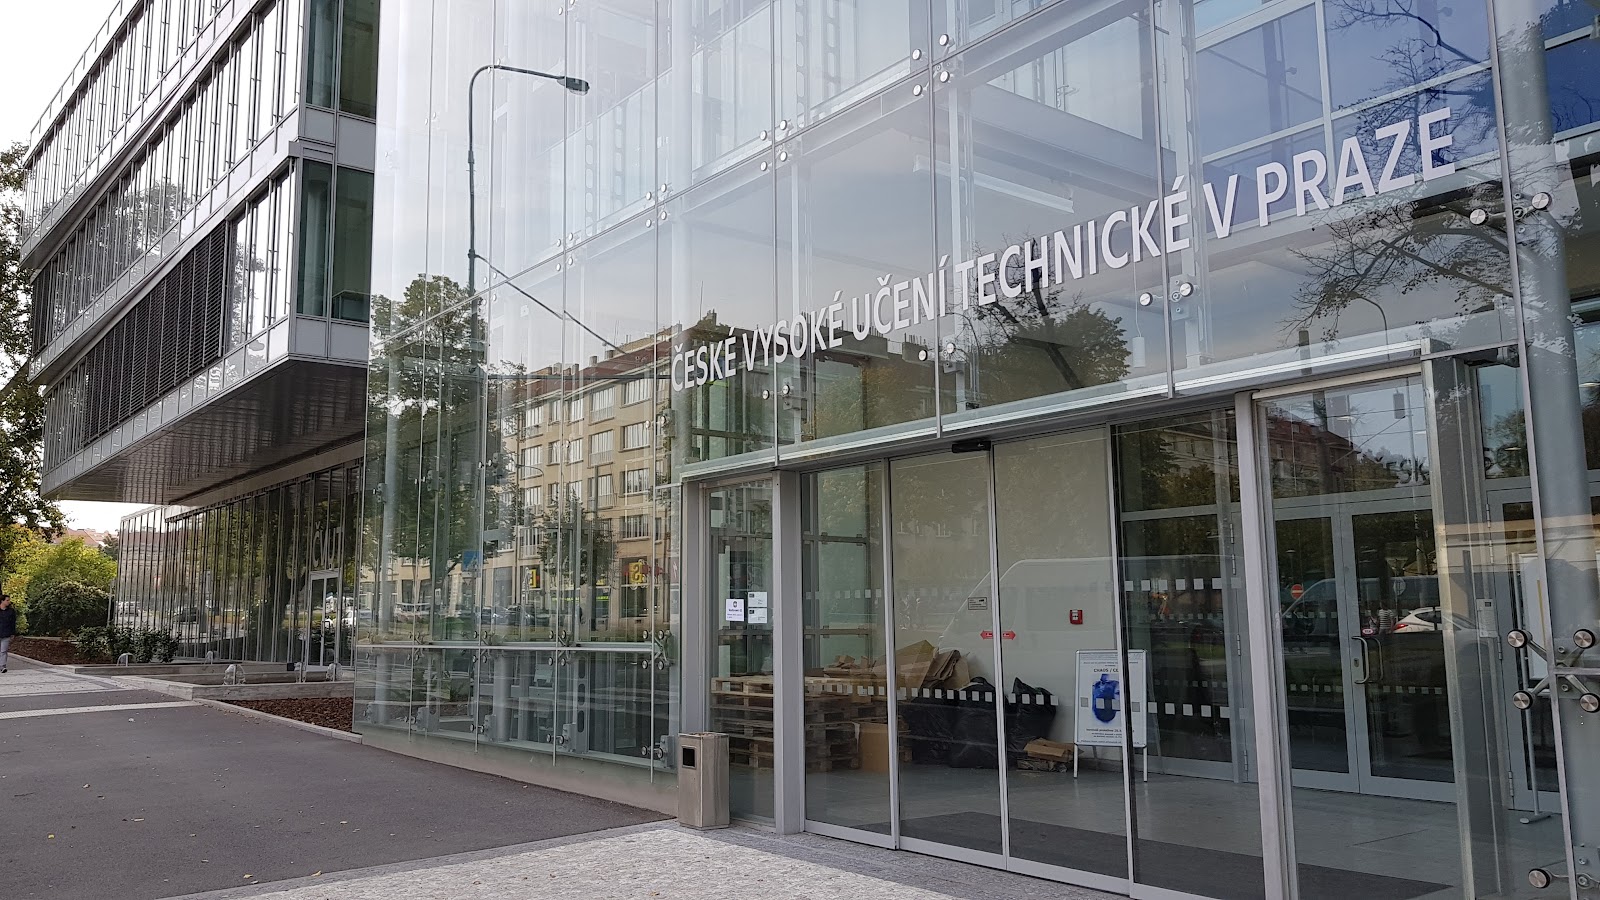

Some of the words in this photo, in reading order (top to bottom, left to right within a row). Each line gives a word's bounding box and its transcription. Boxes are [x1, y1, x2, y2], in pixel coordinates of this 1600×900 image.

[671, 326, 737, 392] ČESKÉ
[742, 290, 843, 371] VYSOKÉ
[852, 254, 950, 341] UČENÍ
[955, 175, 1190, 311] TECHNICKÉ
[1202, 174, 1238, 239] V
[1256, 107, 1456, 227] PRAZE
